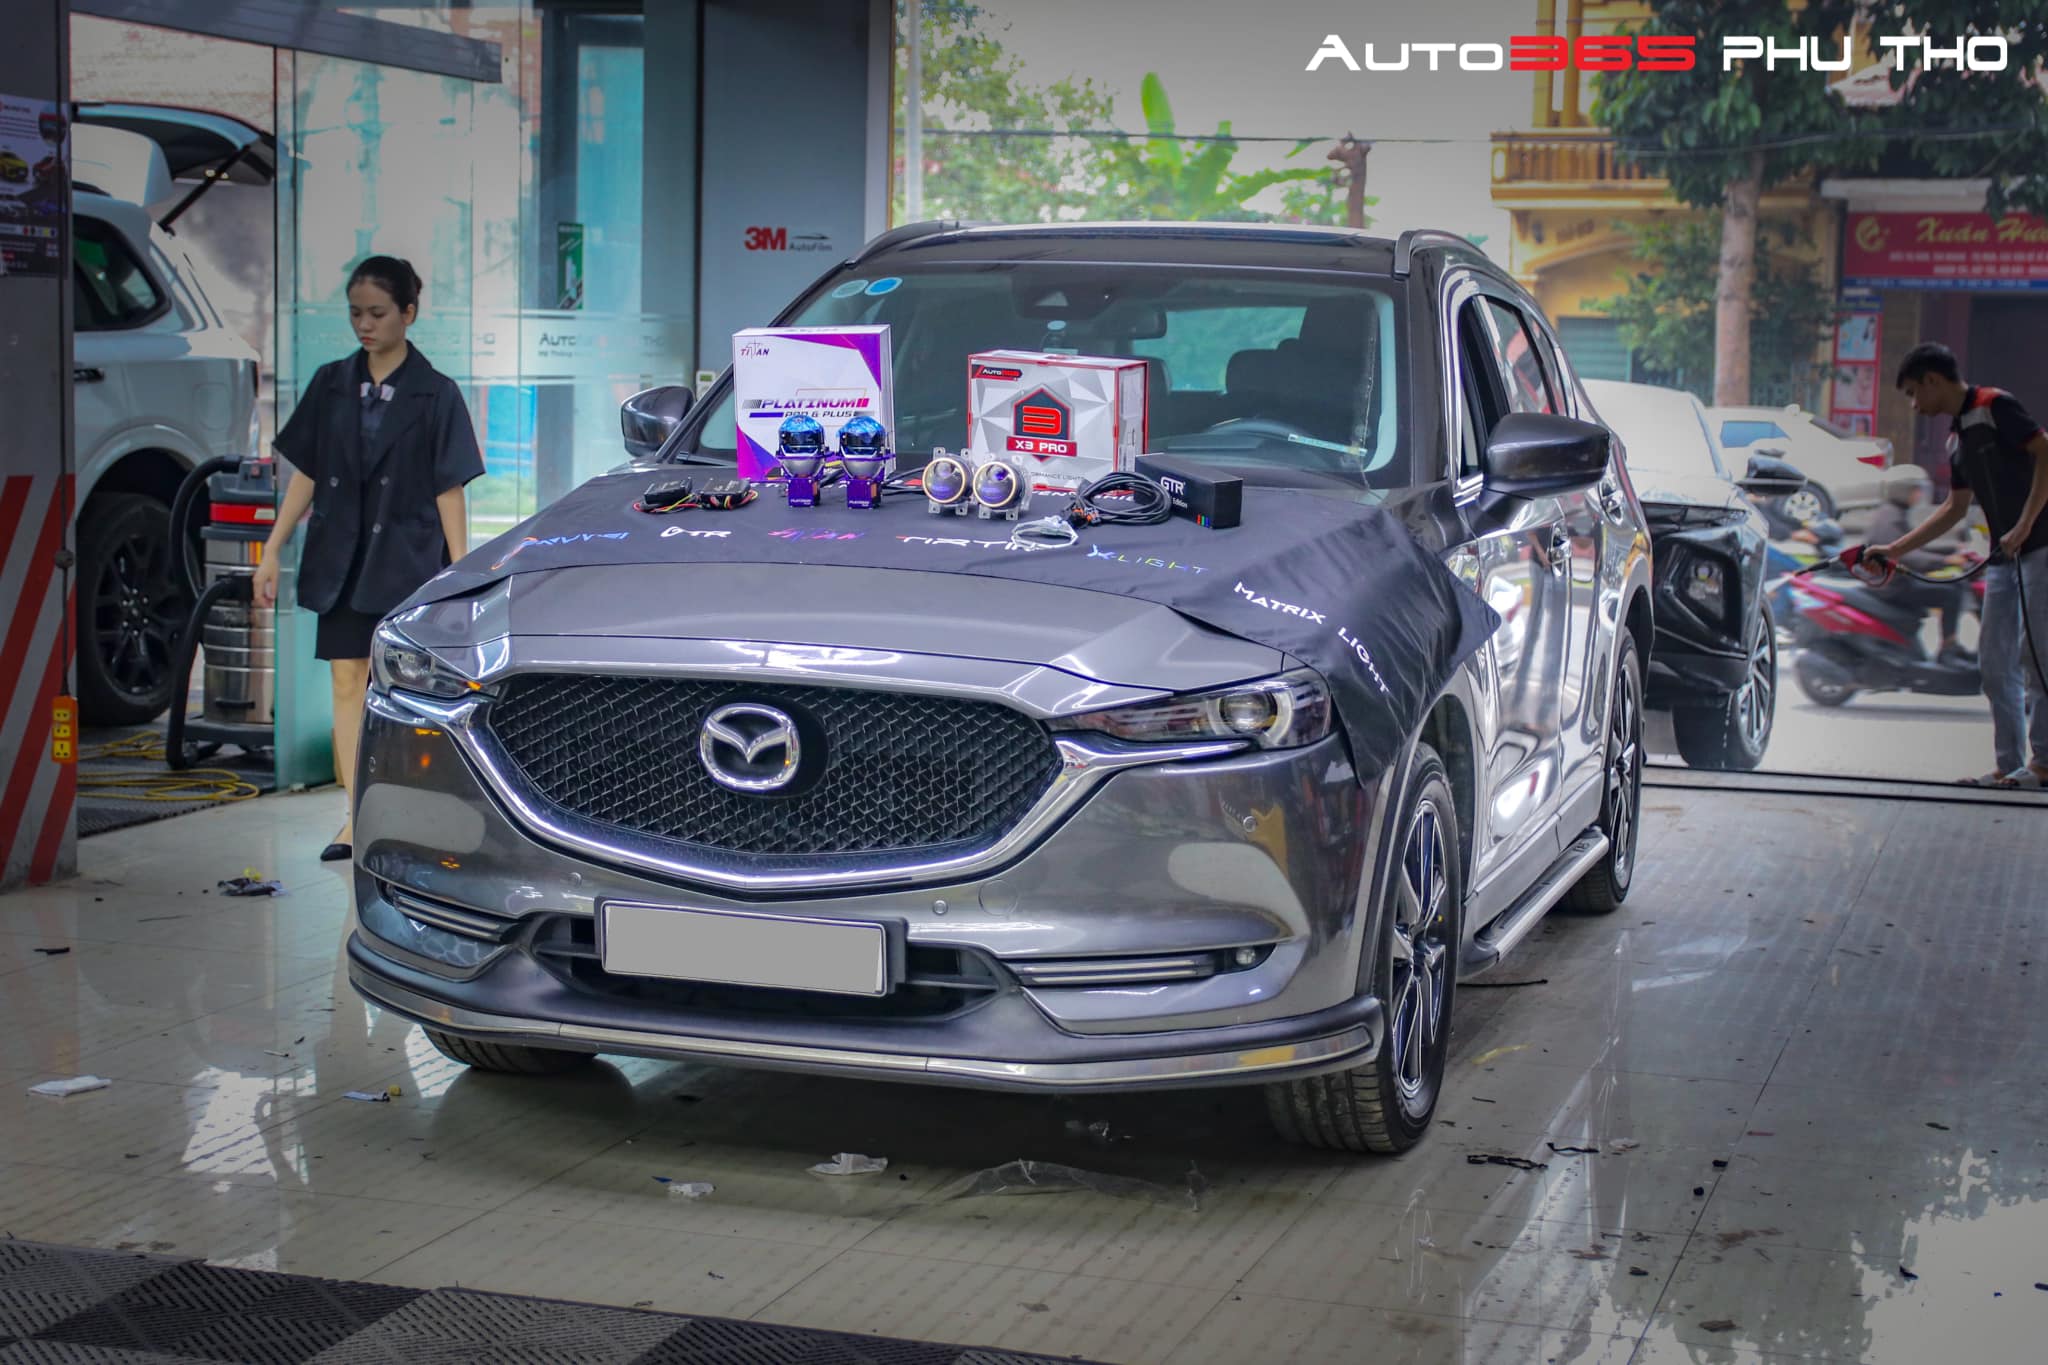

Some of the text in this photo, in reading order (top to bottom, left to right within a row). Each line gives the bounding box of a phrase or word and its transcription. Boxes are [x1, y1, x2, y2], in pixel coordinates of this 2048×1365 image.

[743, 227, 787, 251] 3M
[761, 399, 855, 409] PLATINUM
[822, 410, 852, 418] PLUS
[1015, 440, 1068, 453] X3 PRO
[1160, 476, 1185, 495] GTR
[1233, 581, 1391, 694] MATRIX LIGHT
